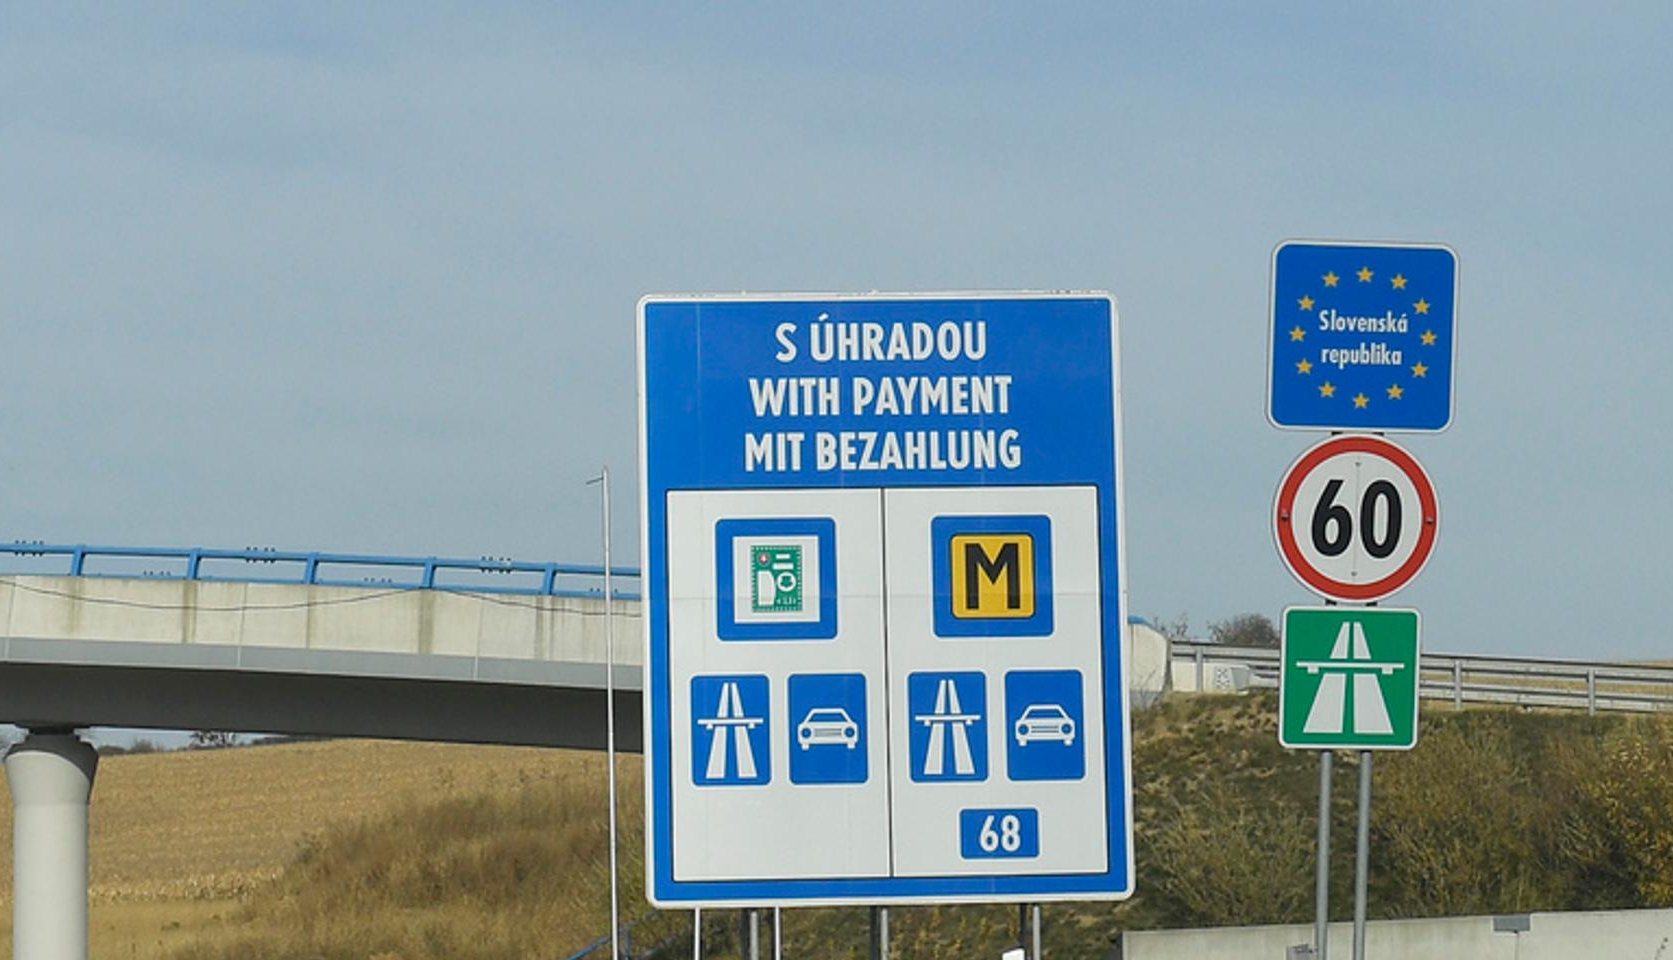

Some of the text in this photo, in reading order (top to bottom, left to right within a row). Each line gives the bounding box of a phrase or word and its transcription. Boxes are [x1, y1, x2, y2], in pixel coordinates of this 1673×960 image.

[775, 313, 986, 363] S ÚHRADOU
[1319, 309, 1408, 334] Slovenská
[1321, 343, 1402, 370] republika
[749, 375, 1012, 417] WITH PAYMENT
[744, 429, 1021, 472] MIT BEZAHLUNG
[1310, 478, 1403, 560] 60
[964, 542, 1021, 610] M
[978, 814, 1021, 853] 68
